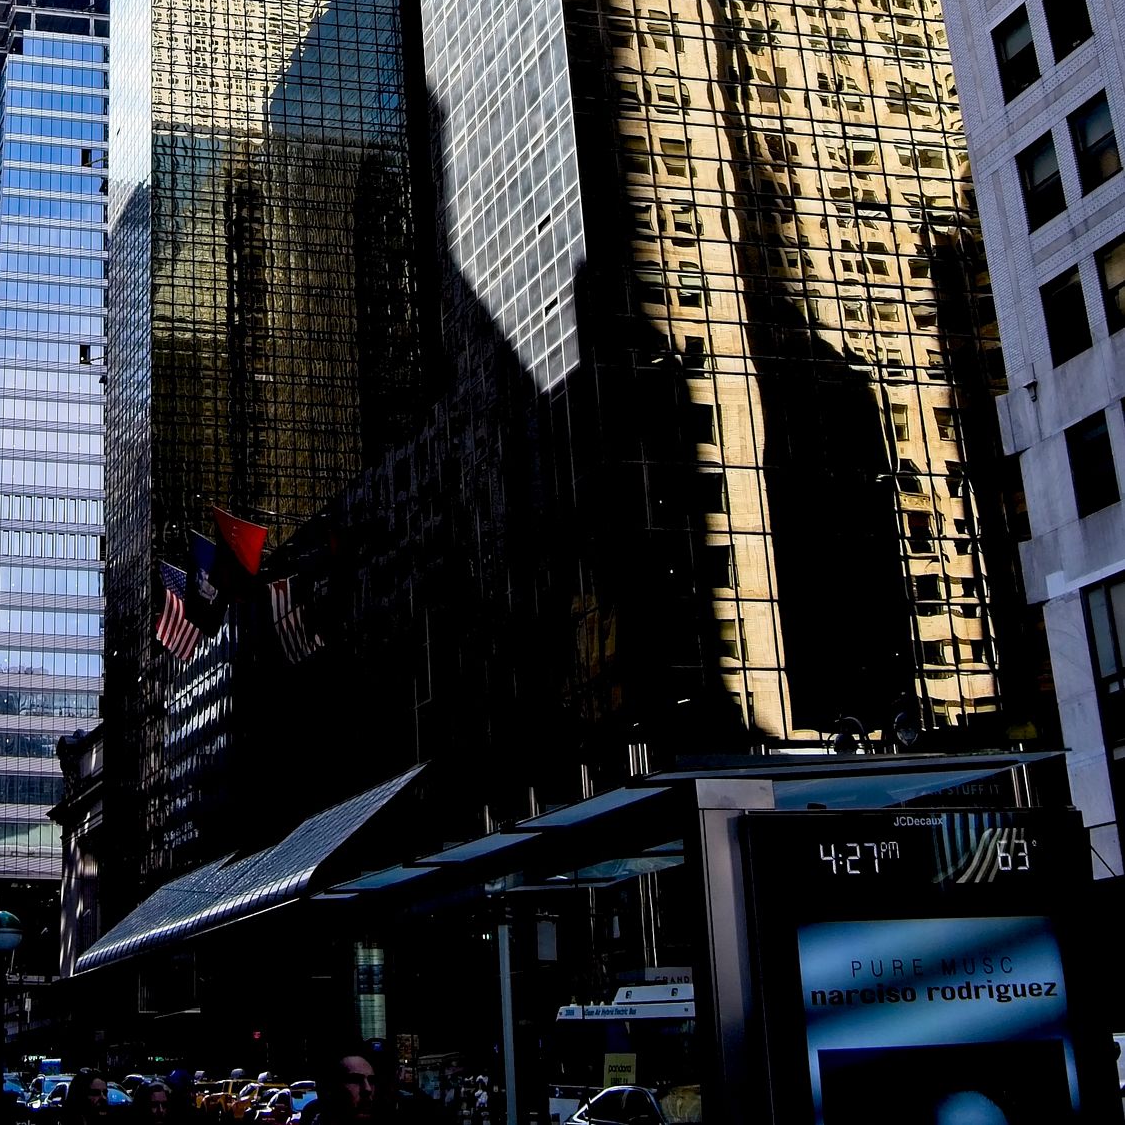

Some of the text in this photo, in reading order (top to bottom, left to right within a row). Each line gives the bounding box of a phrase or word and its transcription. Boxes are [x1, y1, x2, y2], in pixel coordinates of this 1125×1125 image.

[893, 816, 944, 827] JCDecaux
[851, 956, 1013, 977] PURE MUSC
[811, 979, 1058, 1006] narciso rodriguez
